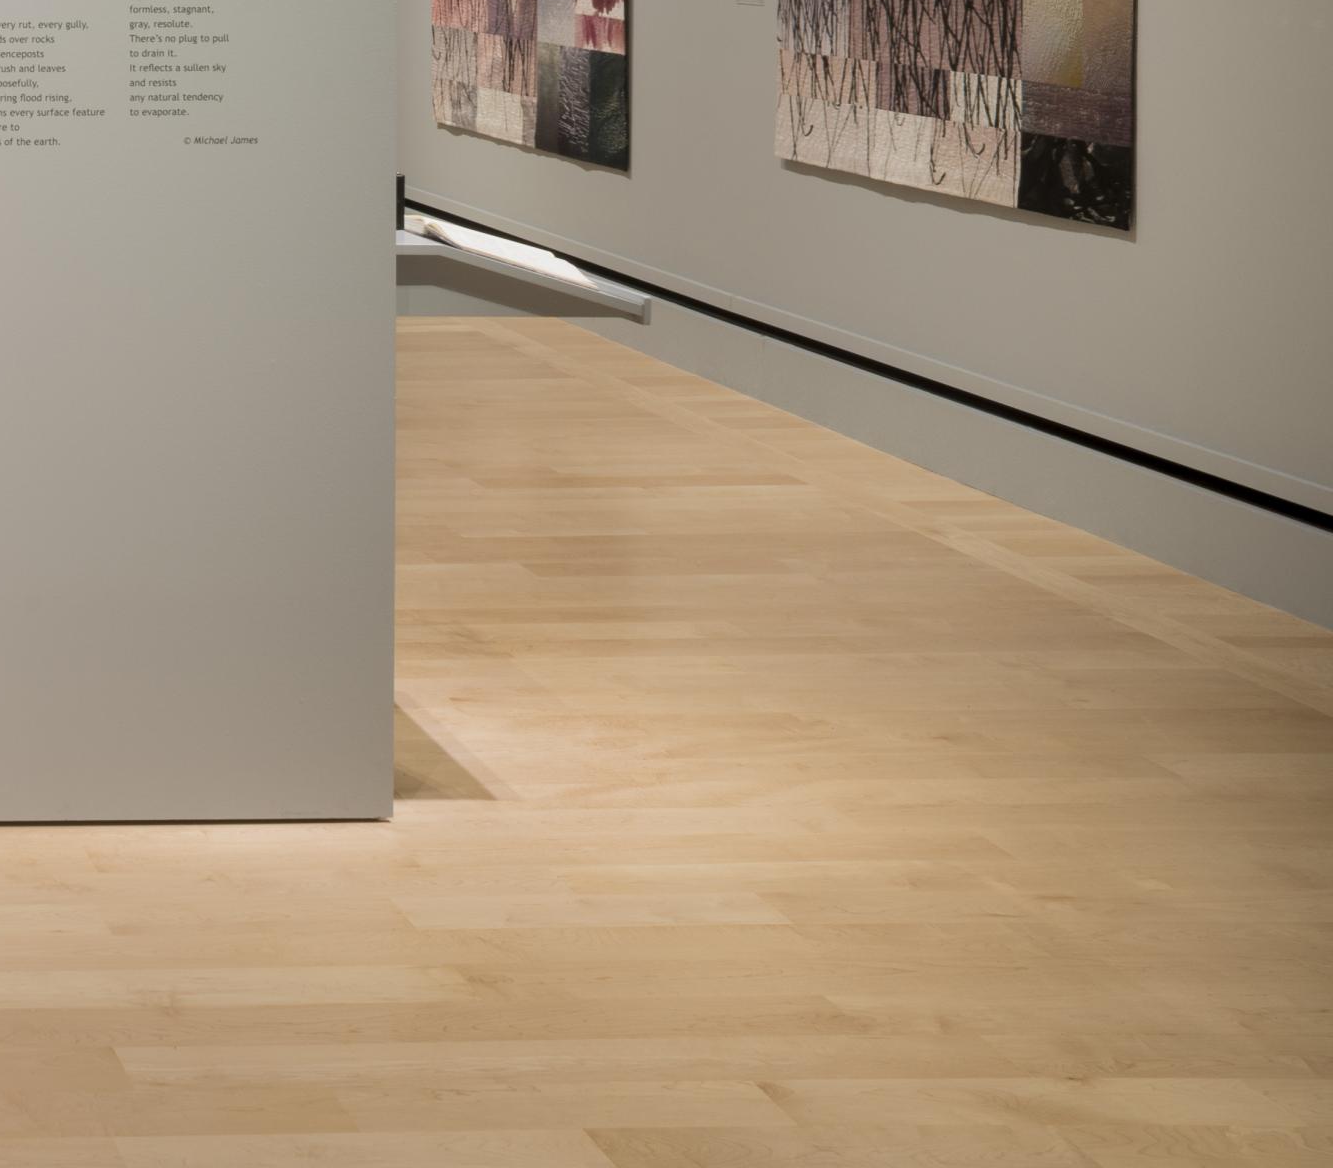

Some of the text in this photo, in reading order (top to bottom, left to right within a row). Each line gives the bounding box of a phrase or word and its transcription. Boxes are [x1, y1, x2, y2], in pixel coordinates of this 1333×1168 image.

[38, 22, 63, 31] every
[31, 35, 55, 43] rocks
[178, 34, 198, 45] plug
[200, 34, 210, 43] to
[212, 34, 229, 45] pull
[129, 49, 140, 58] to
[141, 49, 165, 58] drain
[18, 64, 35, 73] and
[37, 64, 66, 73] leaves
[129, 64, 136, 72] It
[139, 64, 173, 72] reflects
[183, 64, 210, 72] sullen
[212, 64, 227, 74] sky
[129, 78, 177, 87] and resists
[19, 93, 43, 102] flood
[129, 93, 224, 104] any natural tendency
[9, 110, 34, 119] every
[36, 108, 70, 117] surface
[72, 108, 106, 117] feature
[129, 108, 140, 116] to
[10, 122, 20, 131] to
[4, 137, 13, 146] of
[16, 137, 32, 146] the
[194, 136, 228, 144] Michael
[231, 136, 258, 144] James
